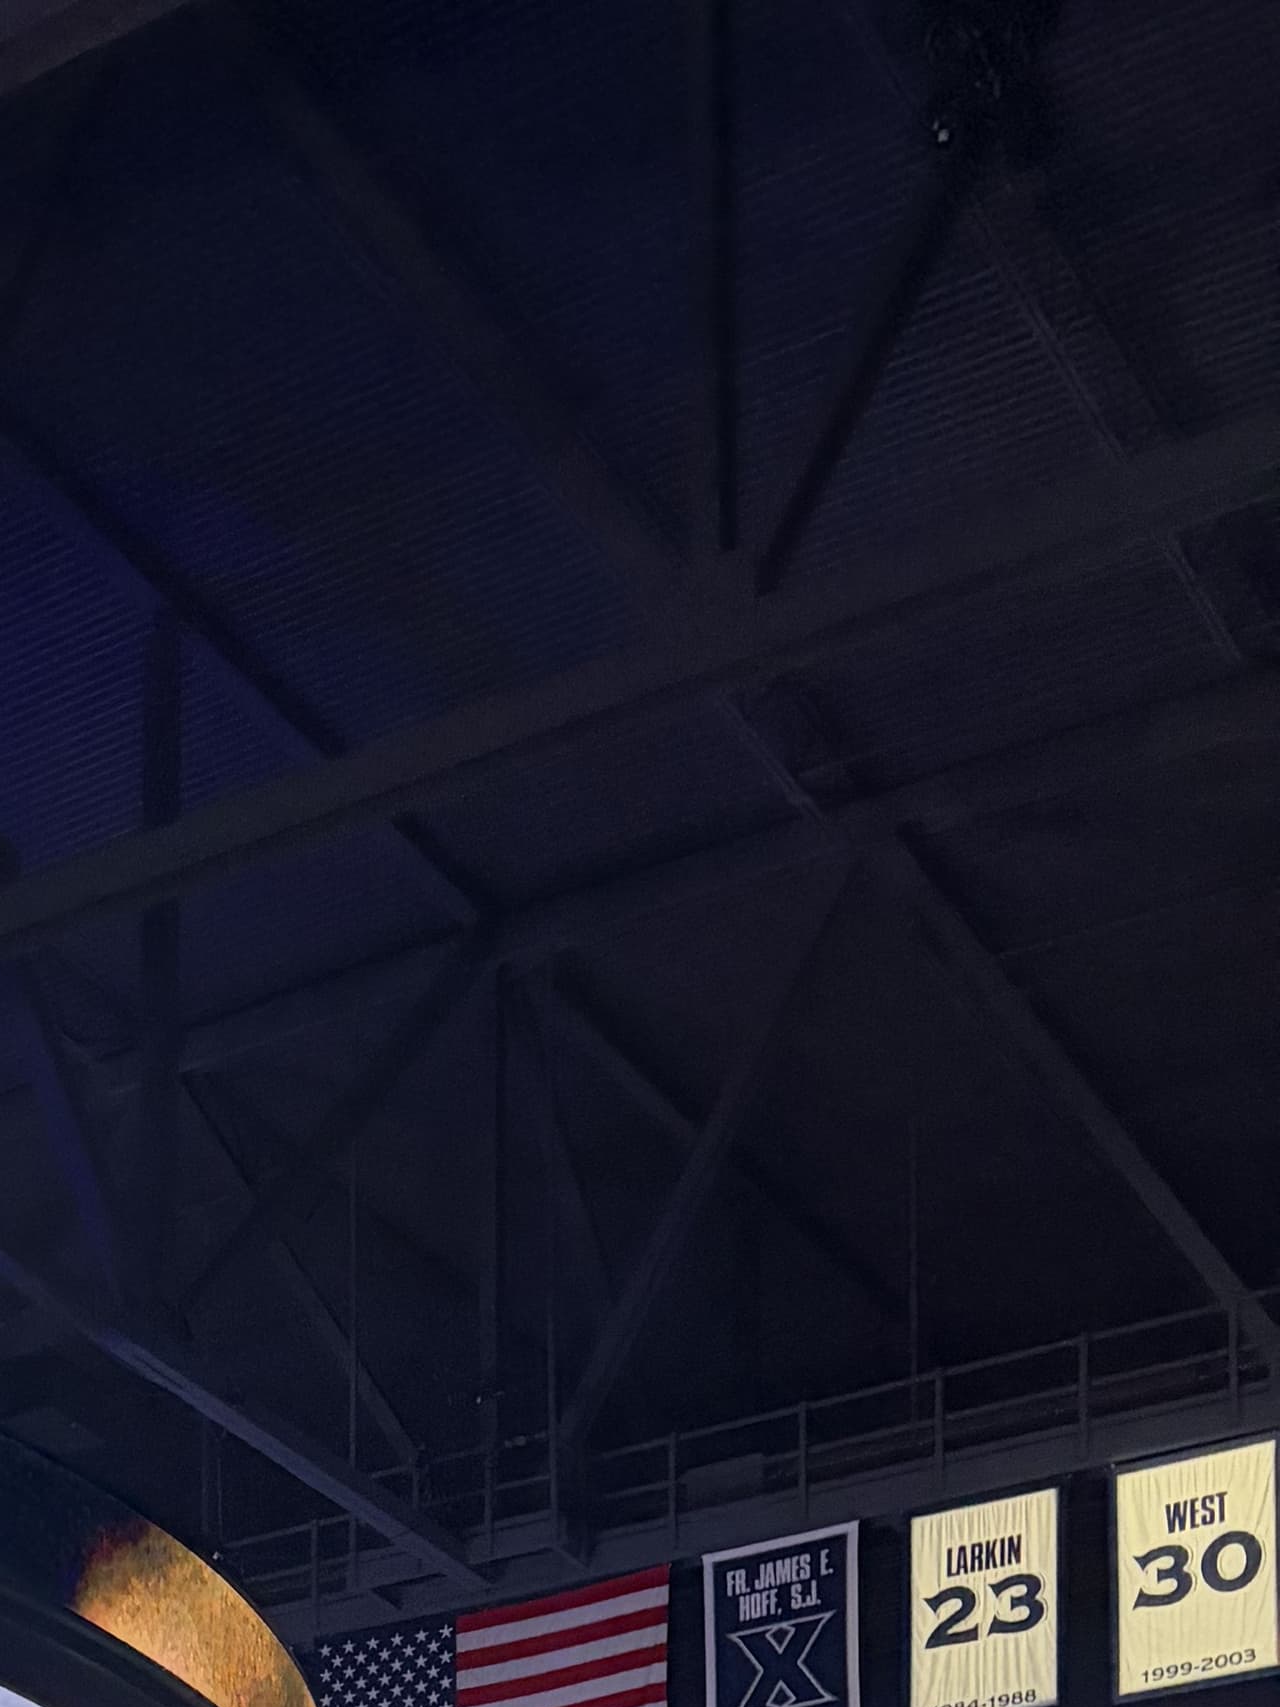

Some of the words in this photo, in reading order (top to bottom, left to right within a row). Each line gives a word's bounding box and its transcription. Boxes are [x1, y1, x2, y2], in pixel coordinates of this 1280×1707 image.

[1165, 1491, 1228, 1535] WEST
[726, 1568, 751, 1598] FR.
[754, 1553, 811, 1591] JAMES
[820, 1548, 834, 1576] E.
[945, 1533, 1023, 1578] LARKIN
[1132, 1530, 1264, 1611] 30
[739, 1588, 782, 1623] HOFF,
[790, 1579, 822, 1610] S.J.
[923, 1573, 1048, 1650] 23
[1141, 1648, 1258, 1685] 1999-2003
